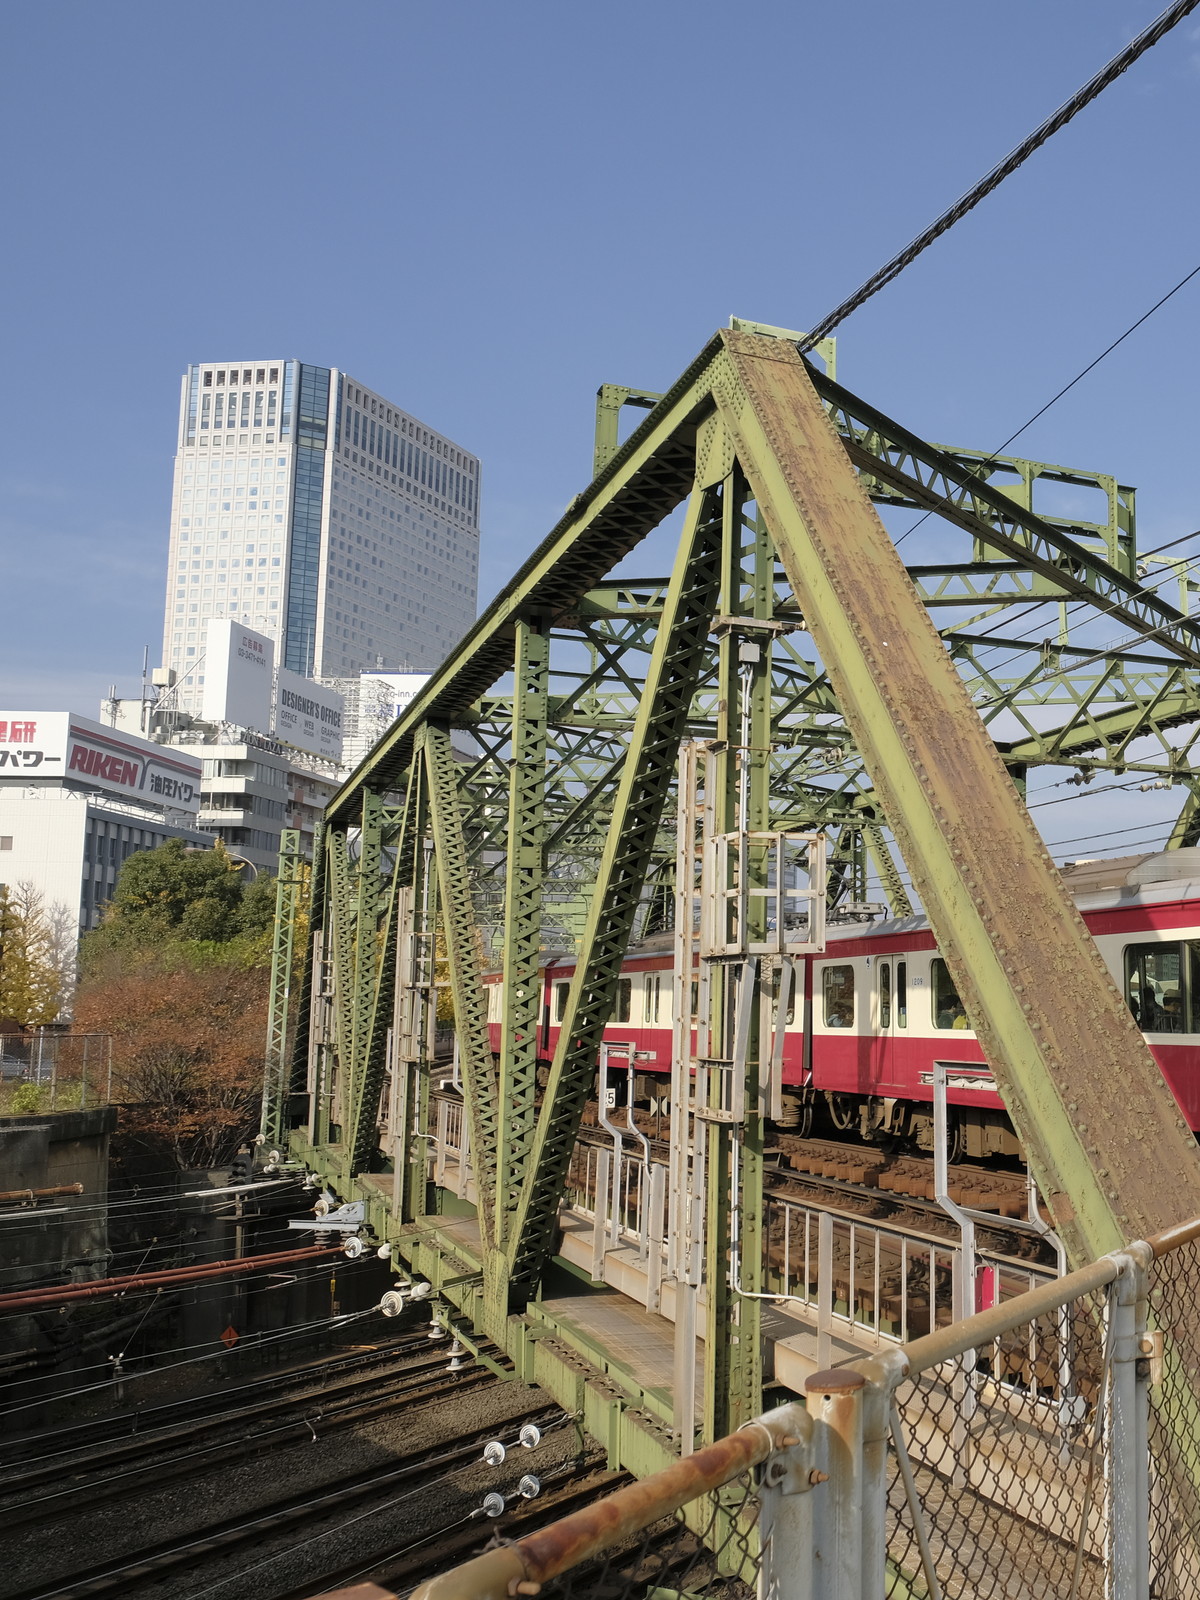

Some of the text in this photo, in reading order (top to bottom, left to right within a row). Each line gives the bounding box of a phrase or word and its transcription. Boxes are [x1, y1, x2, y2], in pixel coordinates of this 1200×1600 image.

[281, 710, 297, 724] OFFICE
[282, 688, 341, 729] DESIGNER'S OFFICE
[304, 720, 315, 731] WEB
[321, 726, 340, 741] GRAPHIC
[68, 743, 139, 787] RIKEN
[150, 773, 201, 803] 油圧パワー
